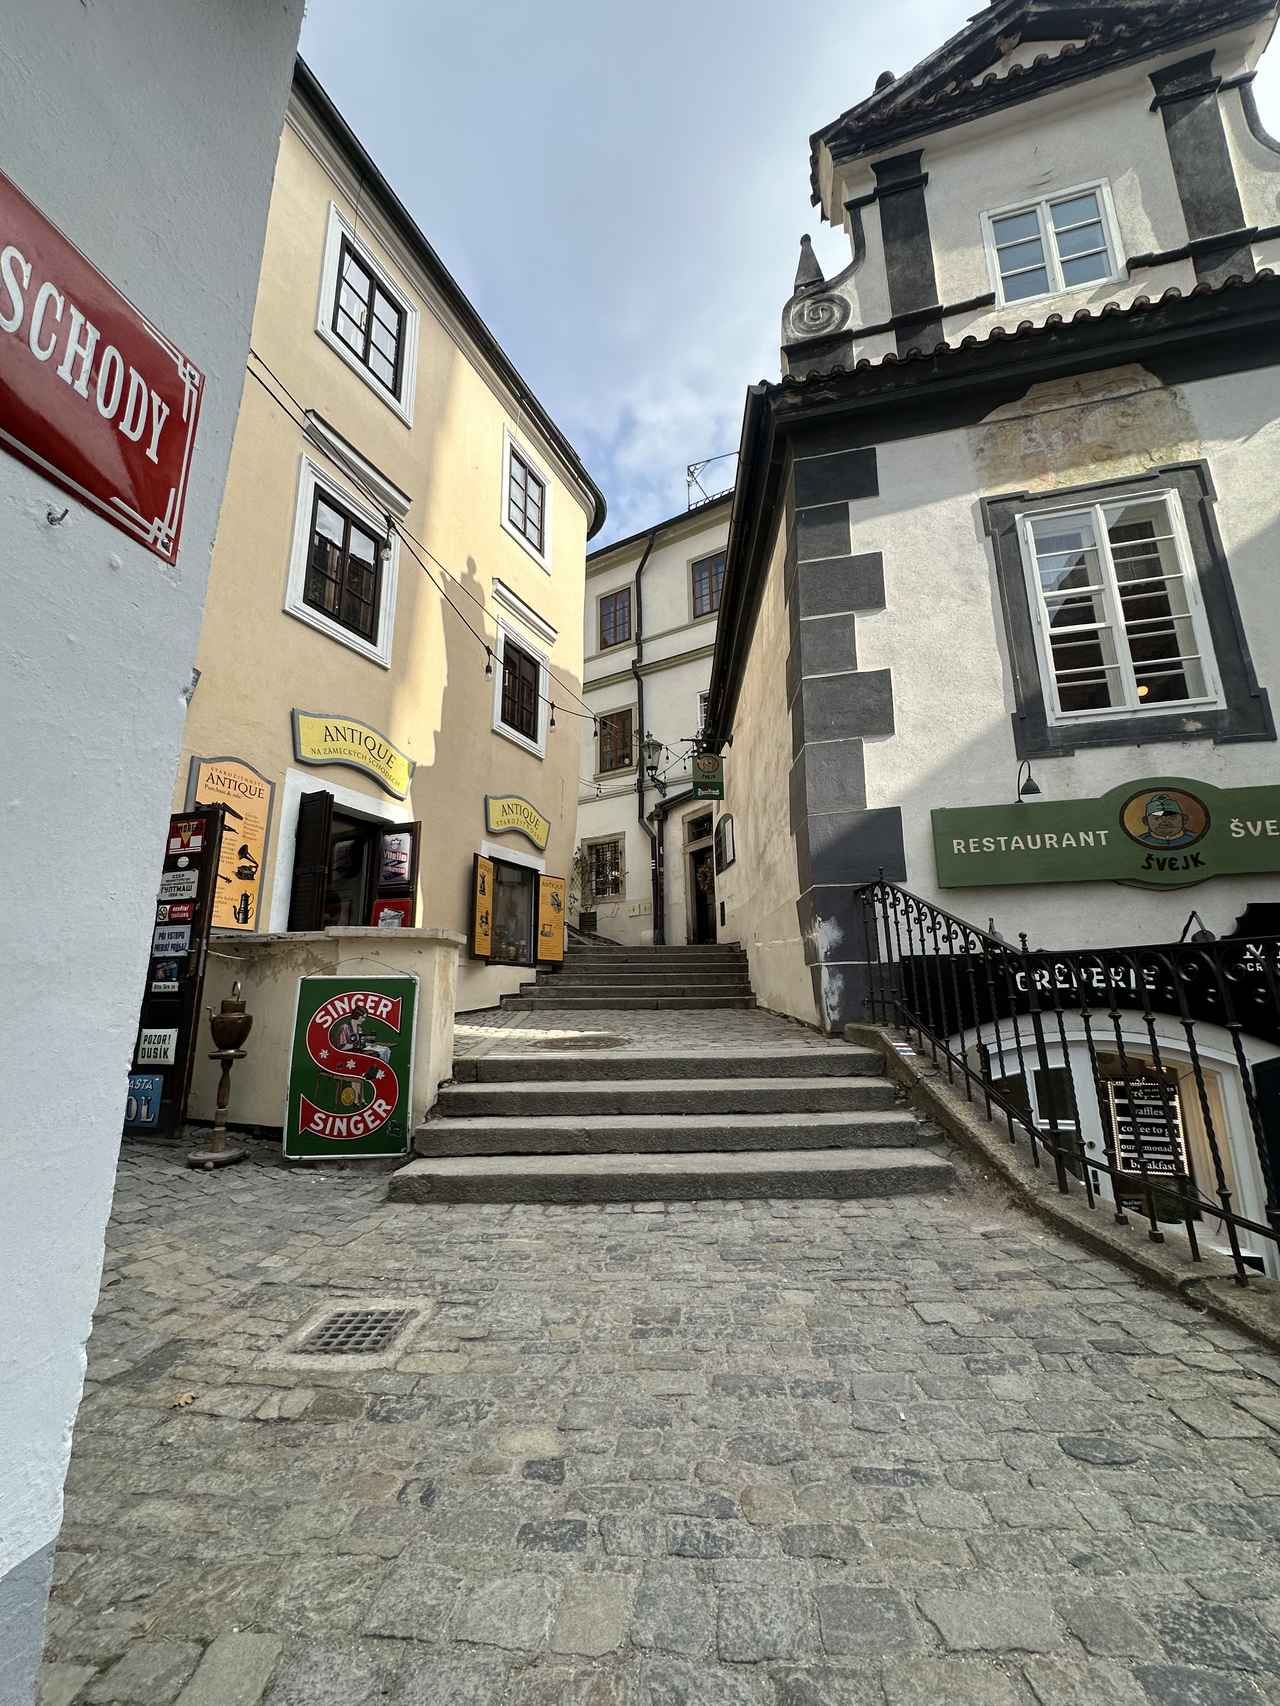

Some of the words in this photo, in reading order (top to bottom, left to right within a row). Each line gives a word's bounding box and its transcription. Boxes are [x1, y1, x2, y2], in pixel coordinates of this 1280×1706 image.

[0, 246, 169, 464] SCHODY
[324, 725, 397, 769] ANTIQUE
[206, 772, 265, 799] ANTIQUE
[502, 803, 541, 831] ANTIQUE
[952, 829, 1109, 855] RESTAURANT
[1141, 851, 1207, 872] ŠVEJK
[315, 993, 393, 1029] SINGER
[143, 1034, 171, 1046] POZOR!
[310, 1098, 392, 1137] SINGER
[1134, 1106, 1165, 1117] affles
[1121, 1124, 1151, 1134] coee
[1121, 1143, 1136, 1151] our
[1130, 1159, 1177, 1171] bakfast
